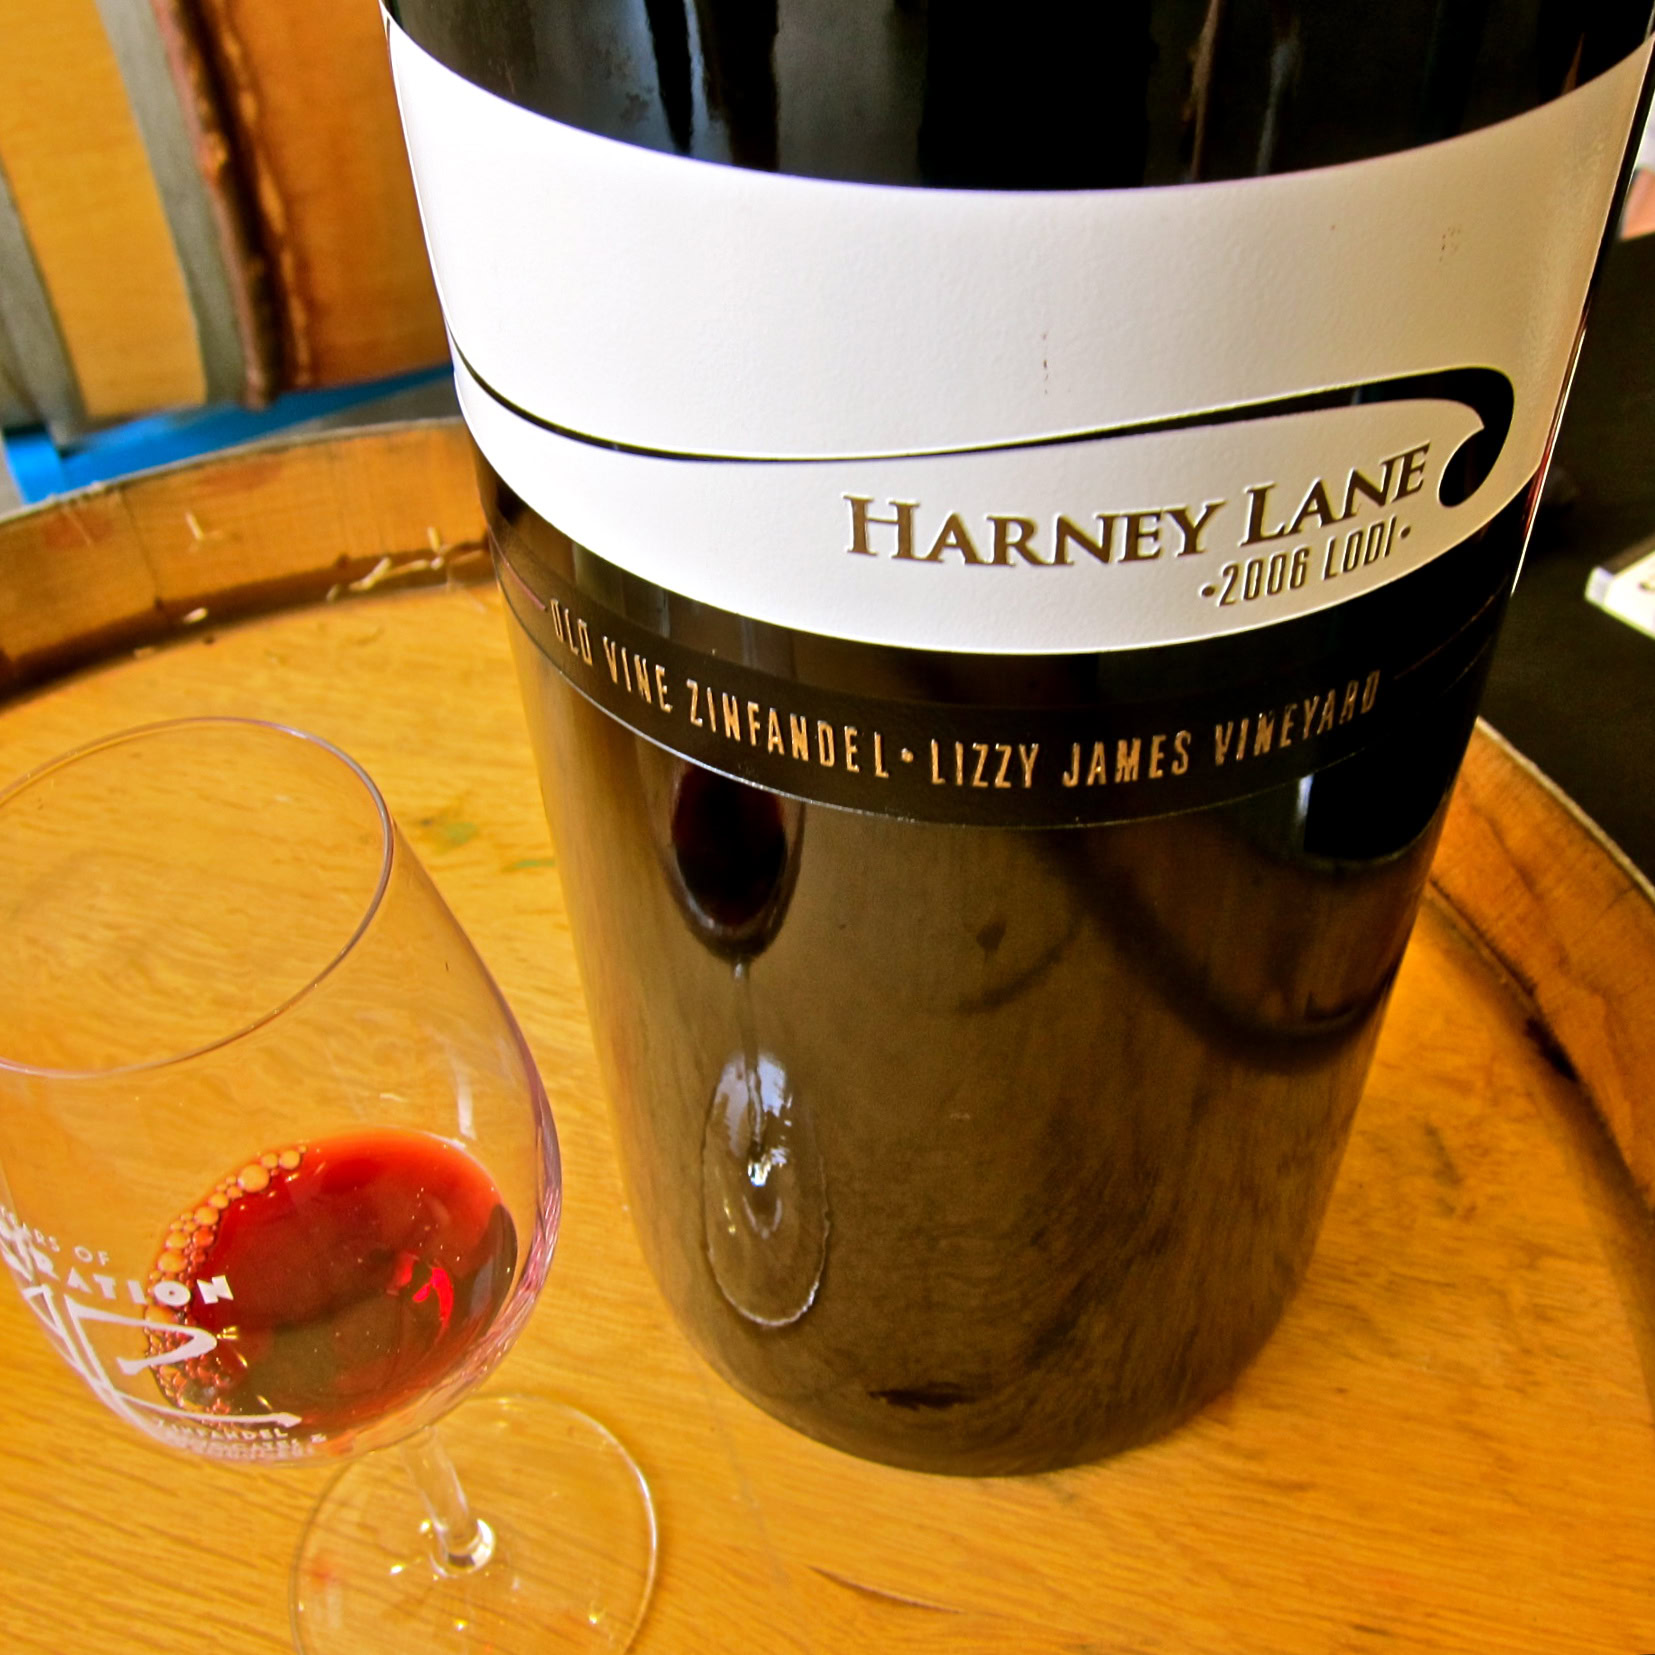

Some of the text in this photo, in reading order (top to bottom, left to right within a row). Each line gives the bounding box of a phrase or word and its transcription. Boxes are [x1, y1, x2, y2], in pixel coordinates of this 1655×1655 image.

[843, 441, 1431, 567] HARNEY LANE
[1216, 520, 1396, 608] 2006 LODI
[549, 597, 1382, 789] OLD VINE ZINFANDEL LIZZY JAMES VINEYARD
[74, 1245, 110, 1267] OF
